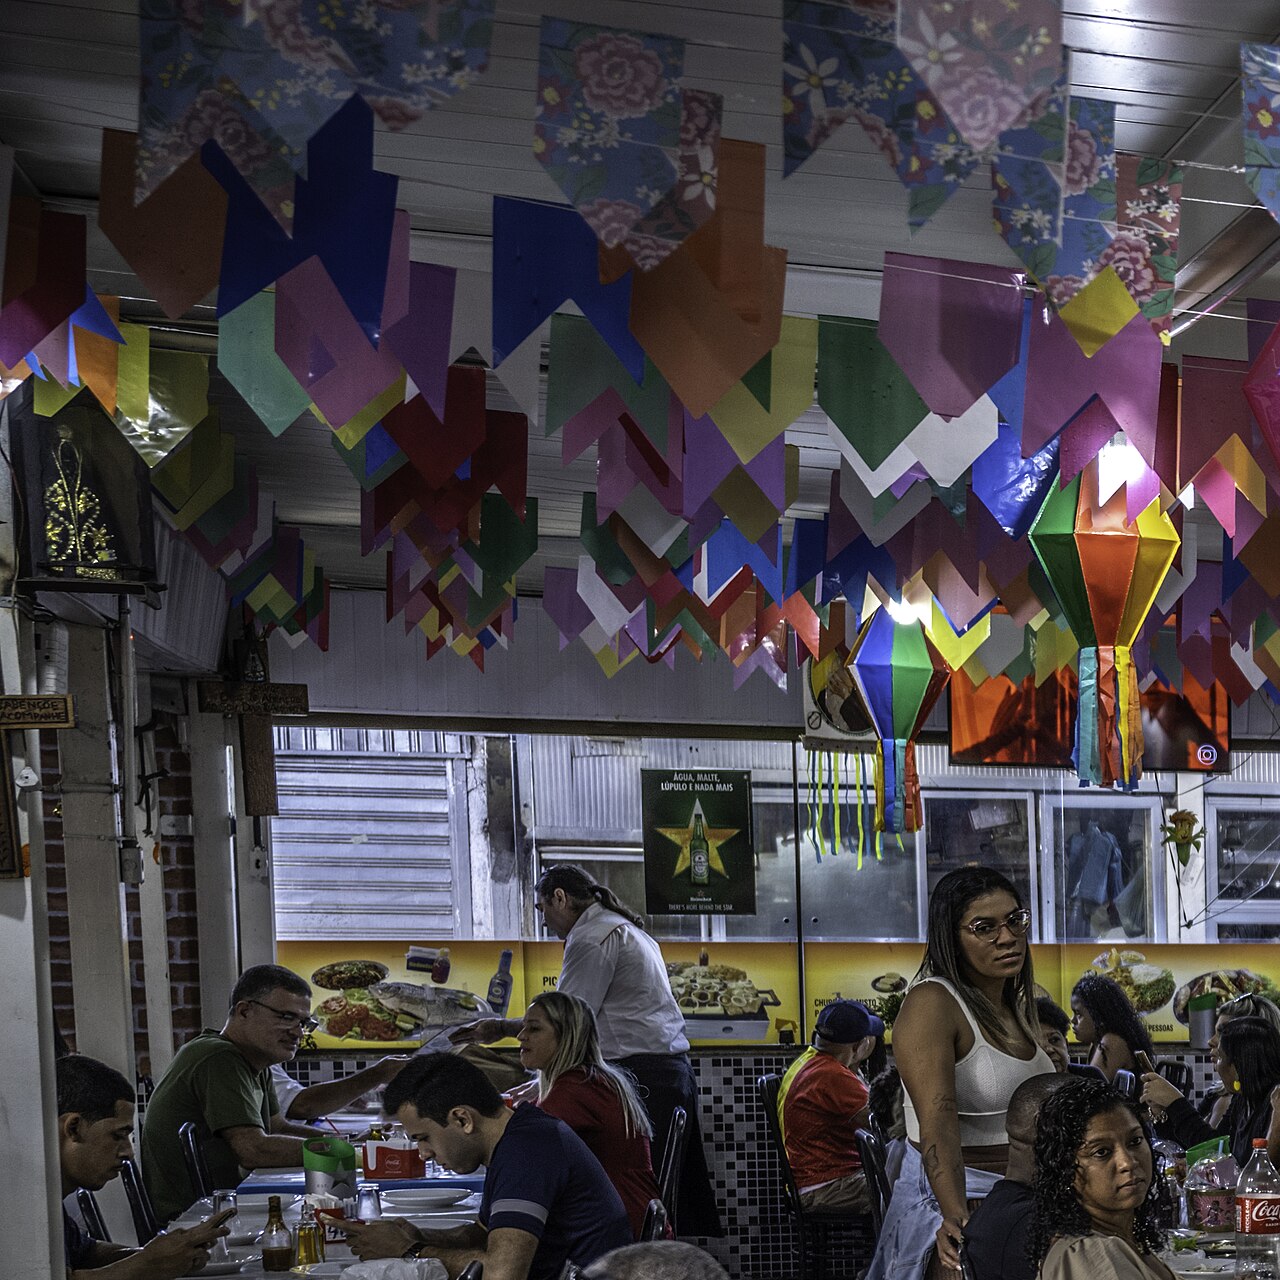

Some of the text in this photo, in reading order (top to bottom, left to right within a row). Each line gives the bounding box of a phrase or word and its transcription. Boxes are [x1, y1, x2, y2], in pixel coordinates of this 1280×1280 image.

[696, 773, 721, 783] MALTE,
[661, 781, 734, 791] LÚPULO E NADA MAIS
[1148, 1024, 1174, 1032] PESSOAS
